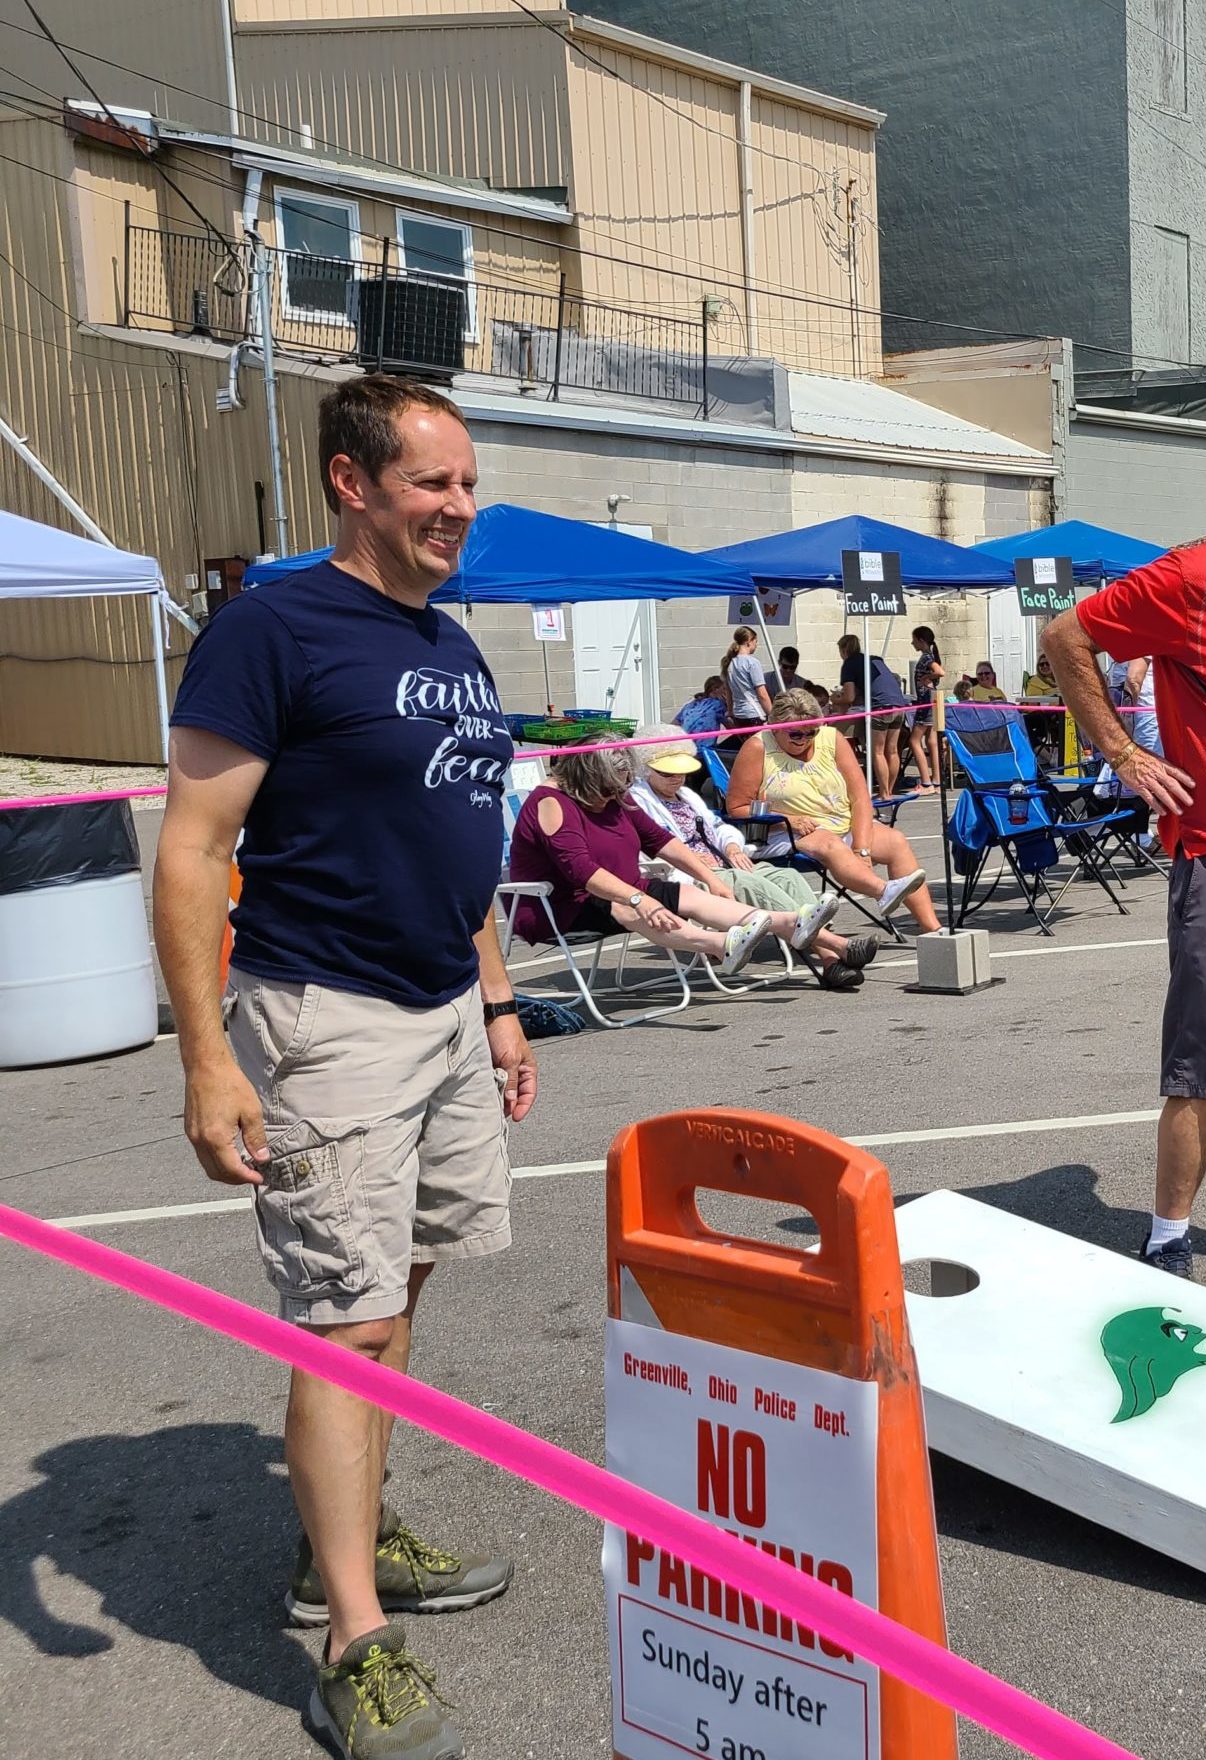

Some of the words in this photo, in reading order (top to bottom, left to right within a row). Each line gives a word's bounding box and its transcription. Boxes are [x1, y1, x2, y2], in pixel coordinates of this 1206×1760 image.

[845, 592, 869, 613] Face
[870, 592, 899, 613] Paint
[1021, 587, 1047, 608] Face
[1048, 587, 1075, 610] Paint
[396, 668, 499, 716] faith
[453, 714, 494, 739] OVER
[685, 1120, 795, 1155] VERTICALCADE
[623, 1352, 692, 1395] Greenville,
[708, 1375, 738, 1405] Ohio
[754, 1387, 796, 1422] Police
[814, 1403, 850, 1437] Dept.
[697, 1417, 766, 1529] NO
[641, 1628, 744, 1704] Sunday
[754, 1676, 828, 1726] after
[695, 1717, 710, 1752] 5
[721, 1737, 766, 1760] am
